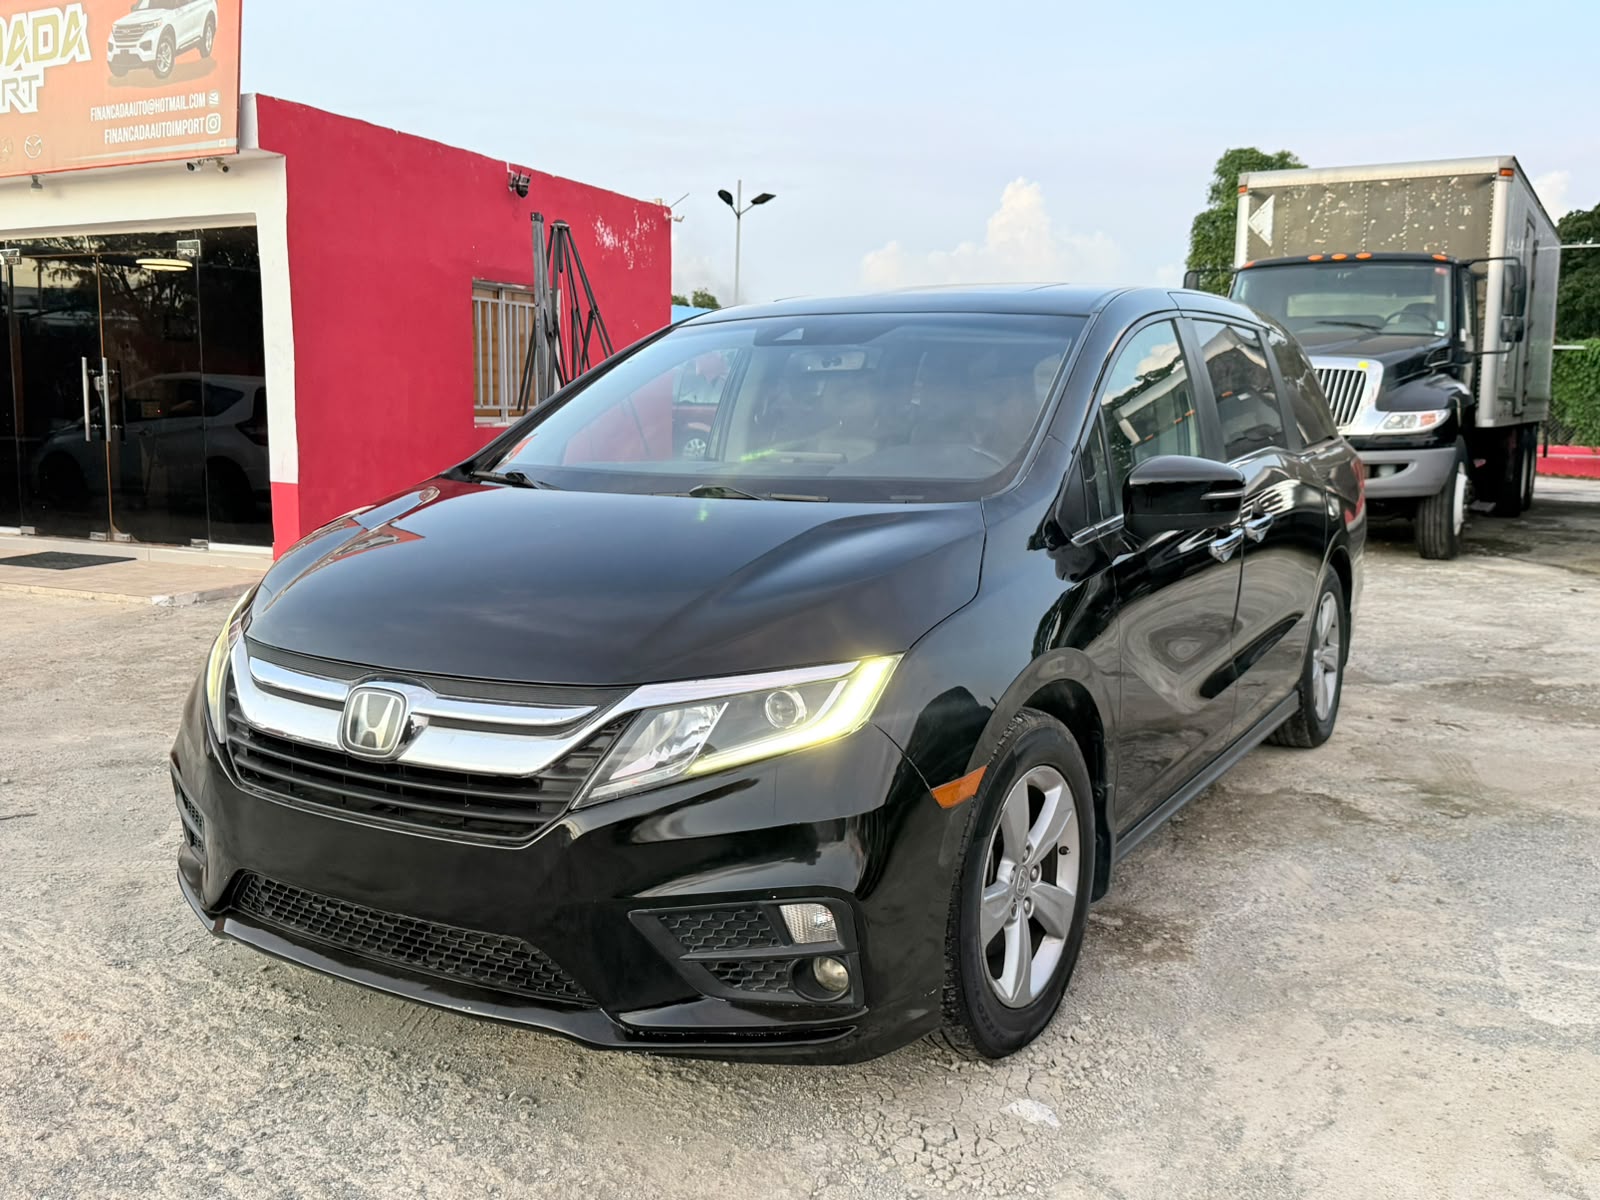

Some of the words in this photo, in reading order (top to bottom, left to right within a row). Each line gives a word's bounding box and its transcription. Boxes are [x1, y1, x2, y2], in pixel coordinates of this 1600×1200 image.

[0, 5, 90, 67] ADA
[90, 92, 206, 121] FINANCADAAUTO@HOTMAIL.COM
[104, 118, 205, 144] FINANCADAAUTOIMPORT
